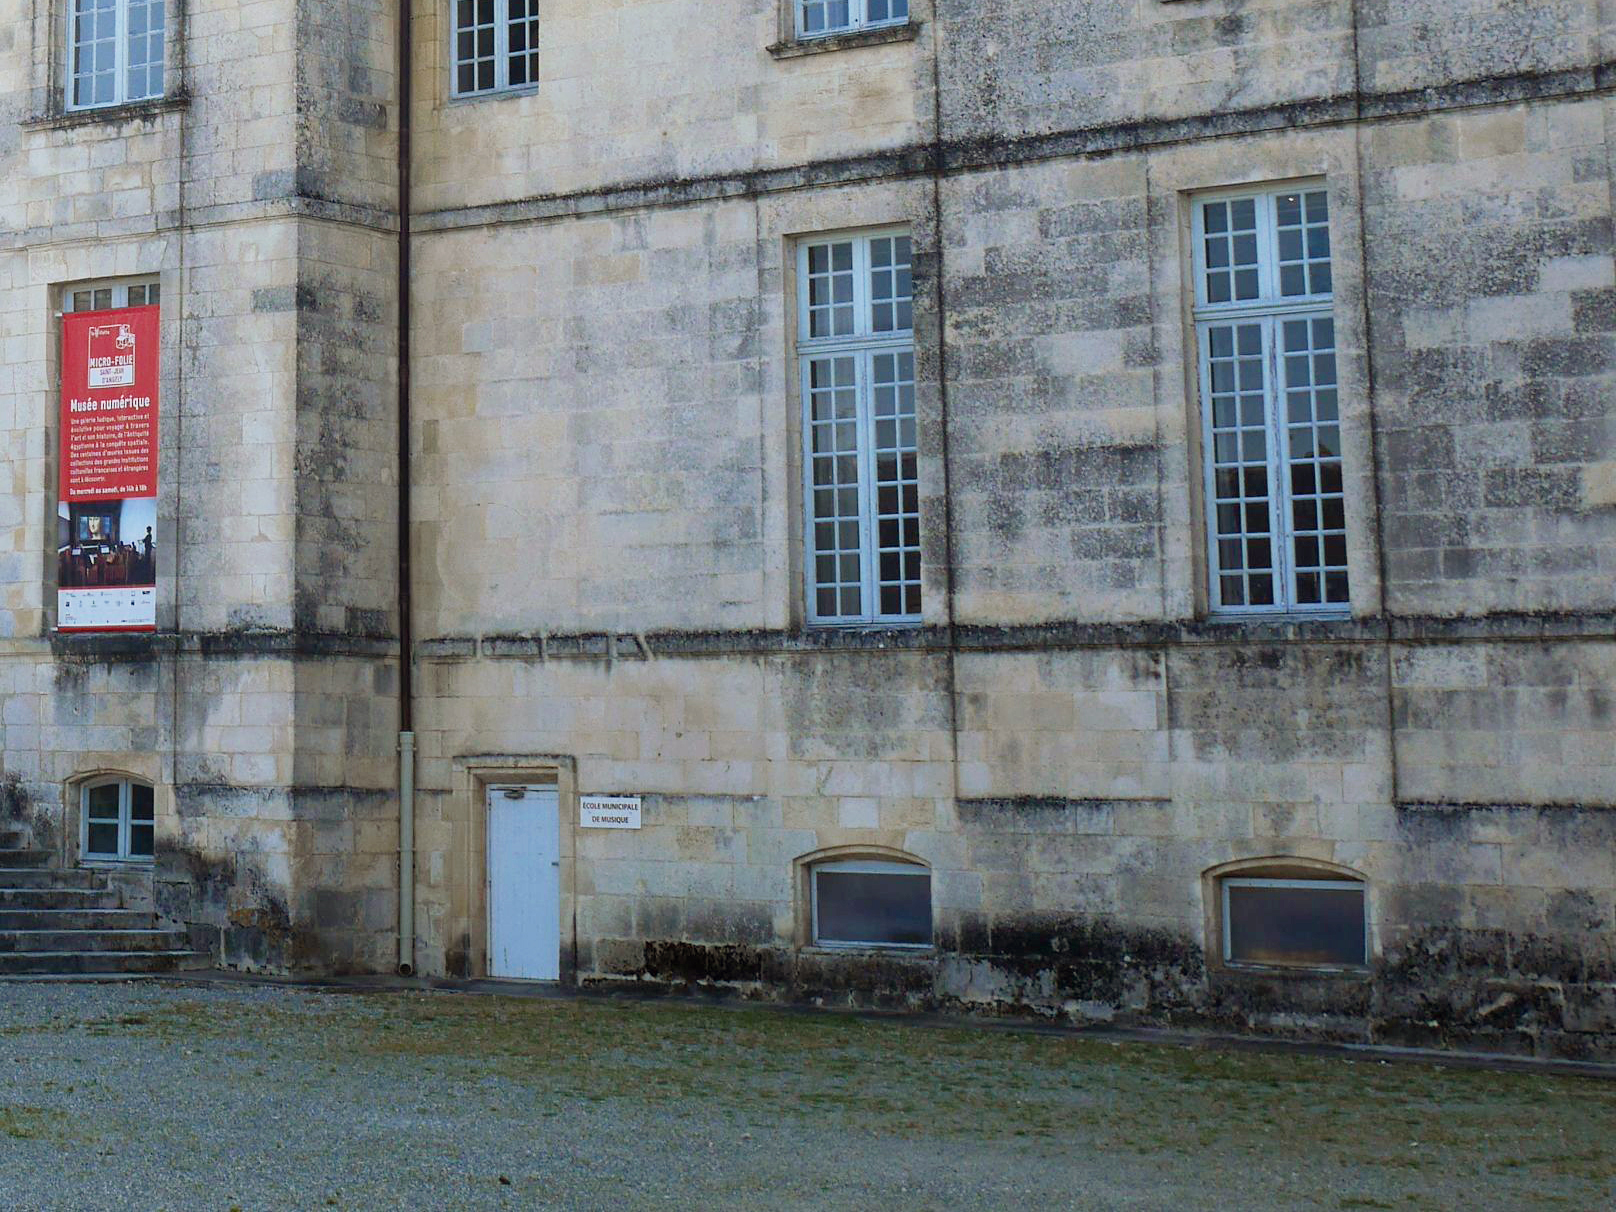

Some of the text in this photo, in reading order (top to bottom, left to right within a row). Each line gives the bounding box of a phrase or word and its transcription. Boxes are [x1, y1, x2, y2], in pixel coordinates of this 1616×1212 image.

[90, 354, 133, 367] MICRO-FOLIE
[71, 395, 150, 412] Musée numérique
